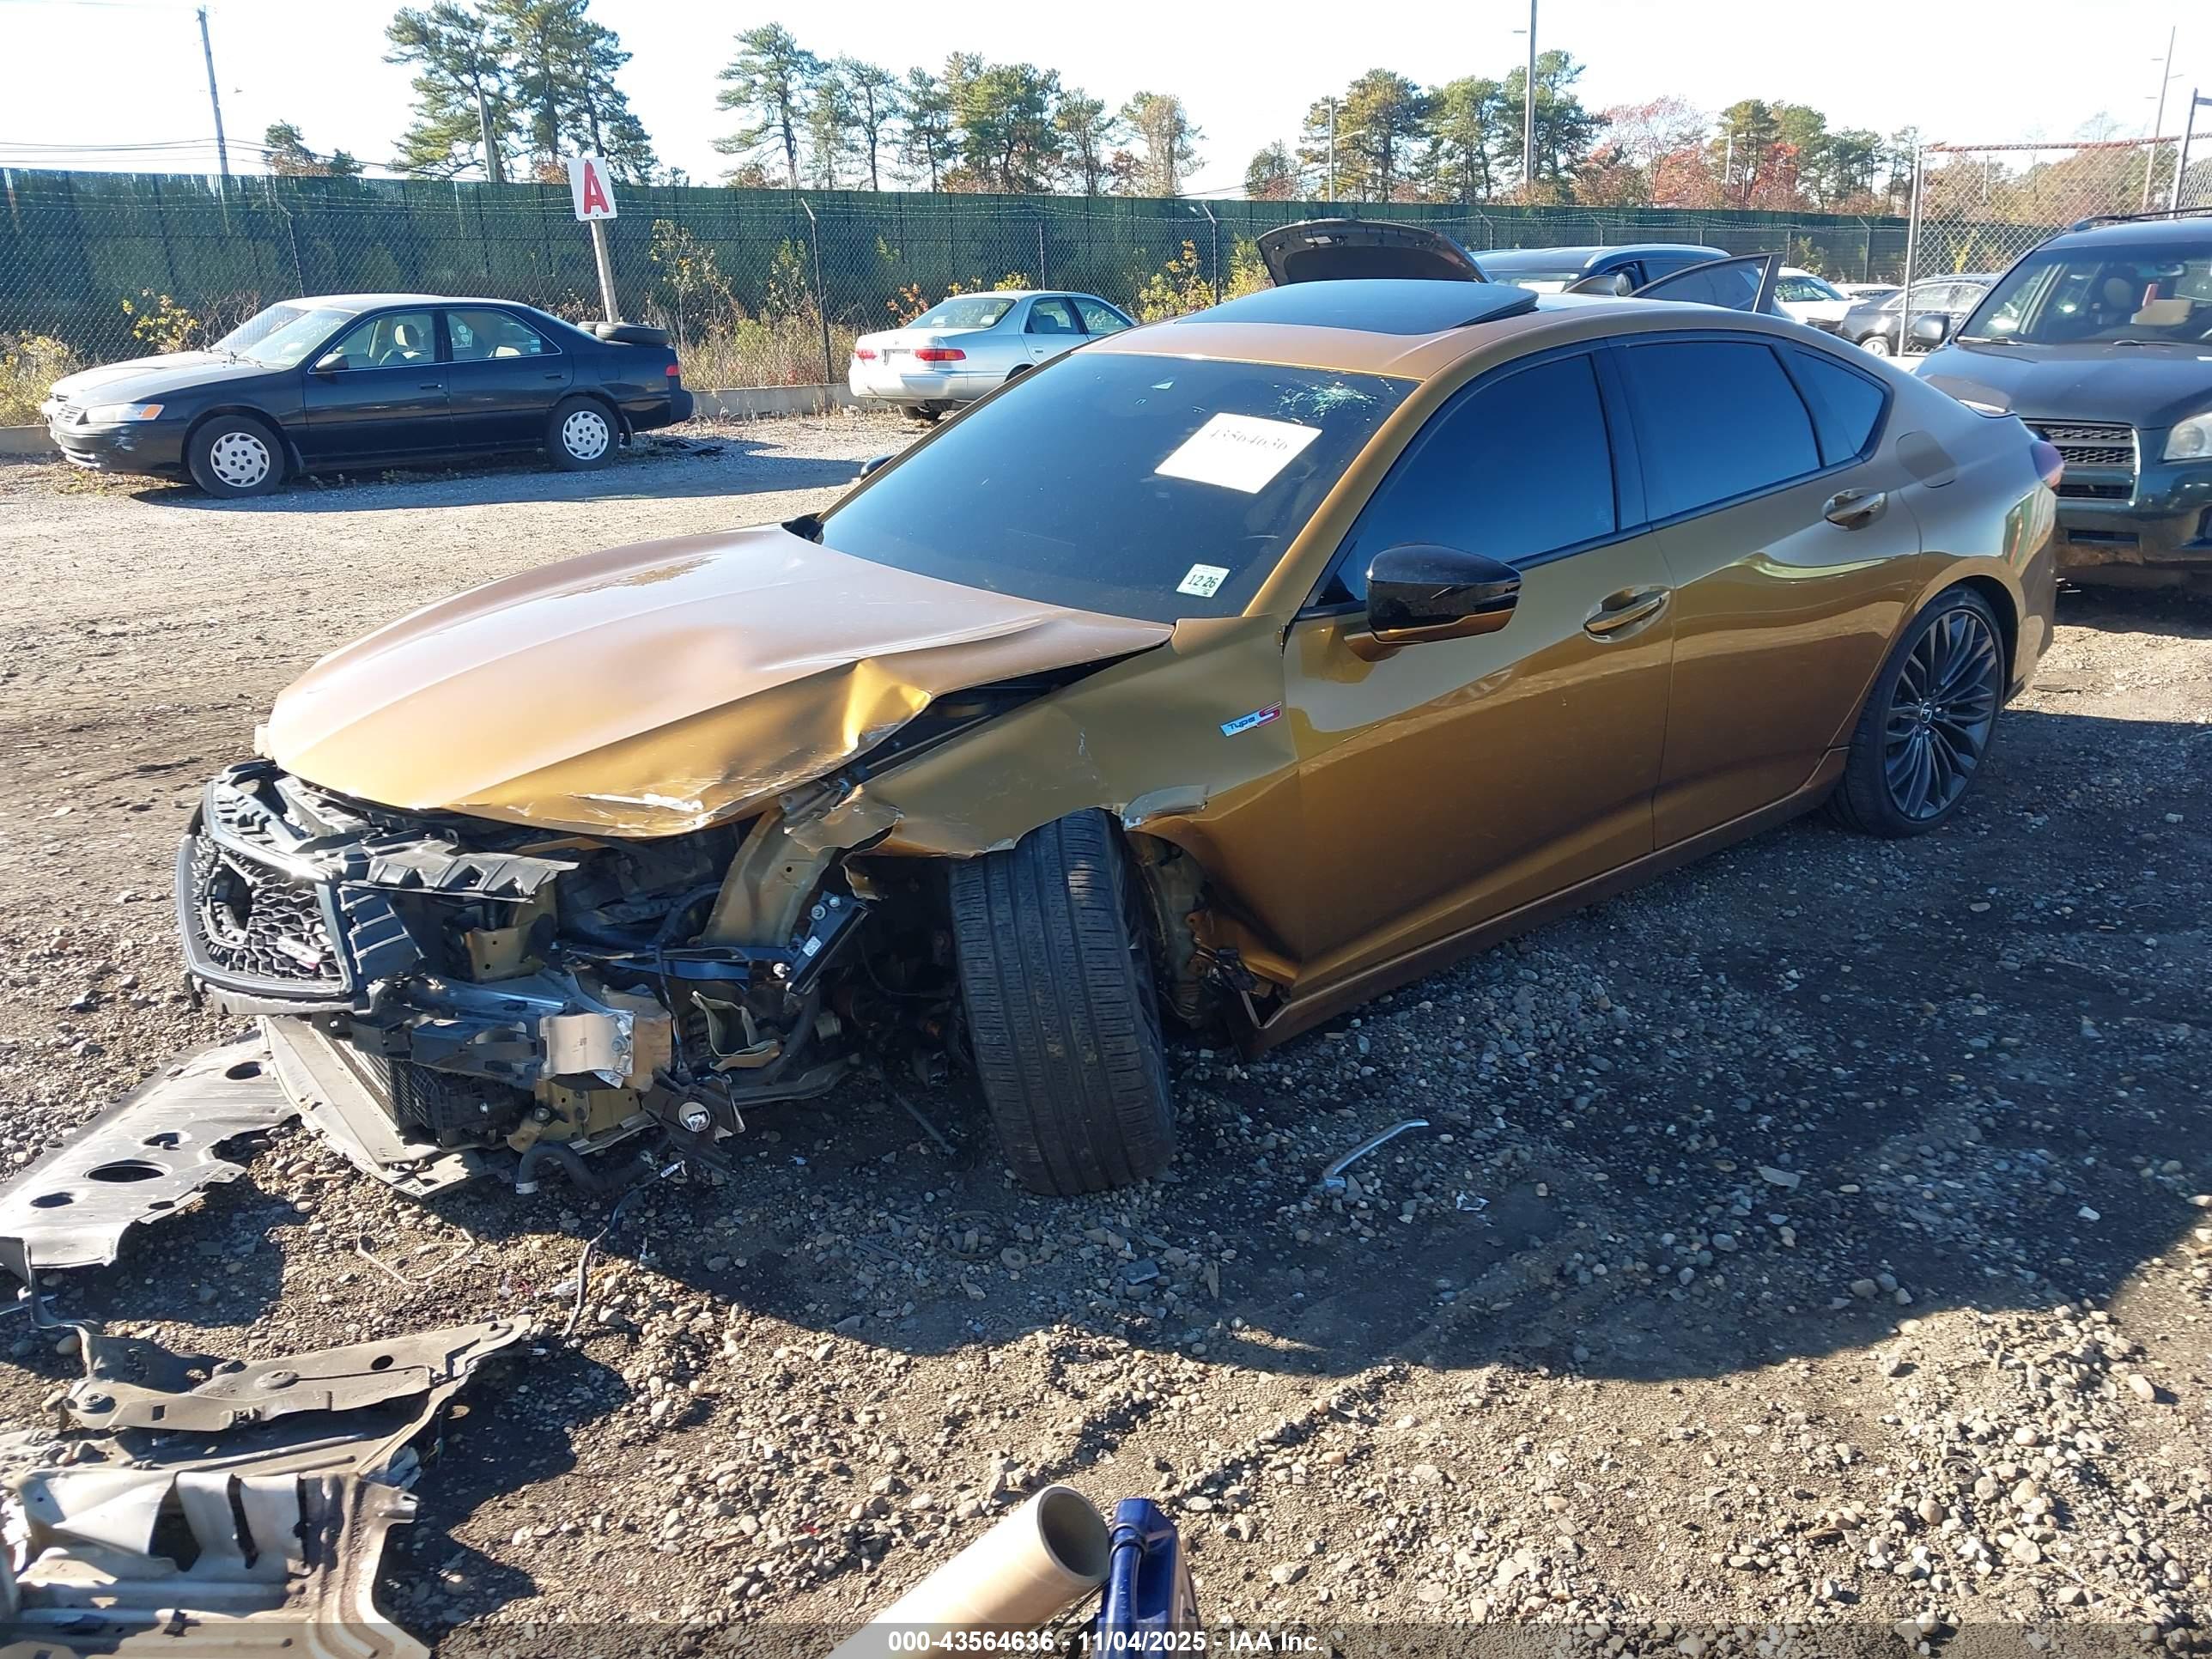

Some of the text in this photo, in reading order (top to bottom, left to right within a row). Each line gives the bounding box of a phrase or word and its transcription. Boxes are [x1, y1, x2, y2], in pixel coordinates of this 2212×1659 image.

[584, 162, 610, 214] A
[1227, 701, 1282, 731] Type S
